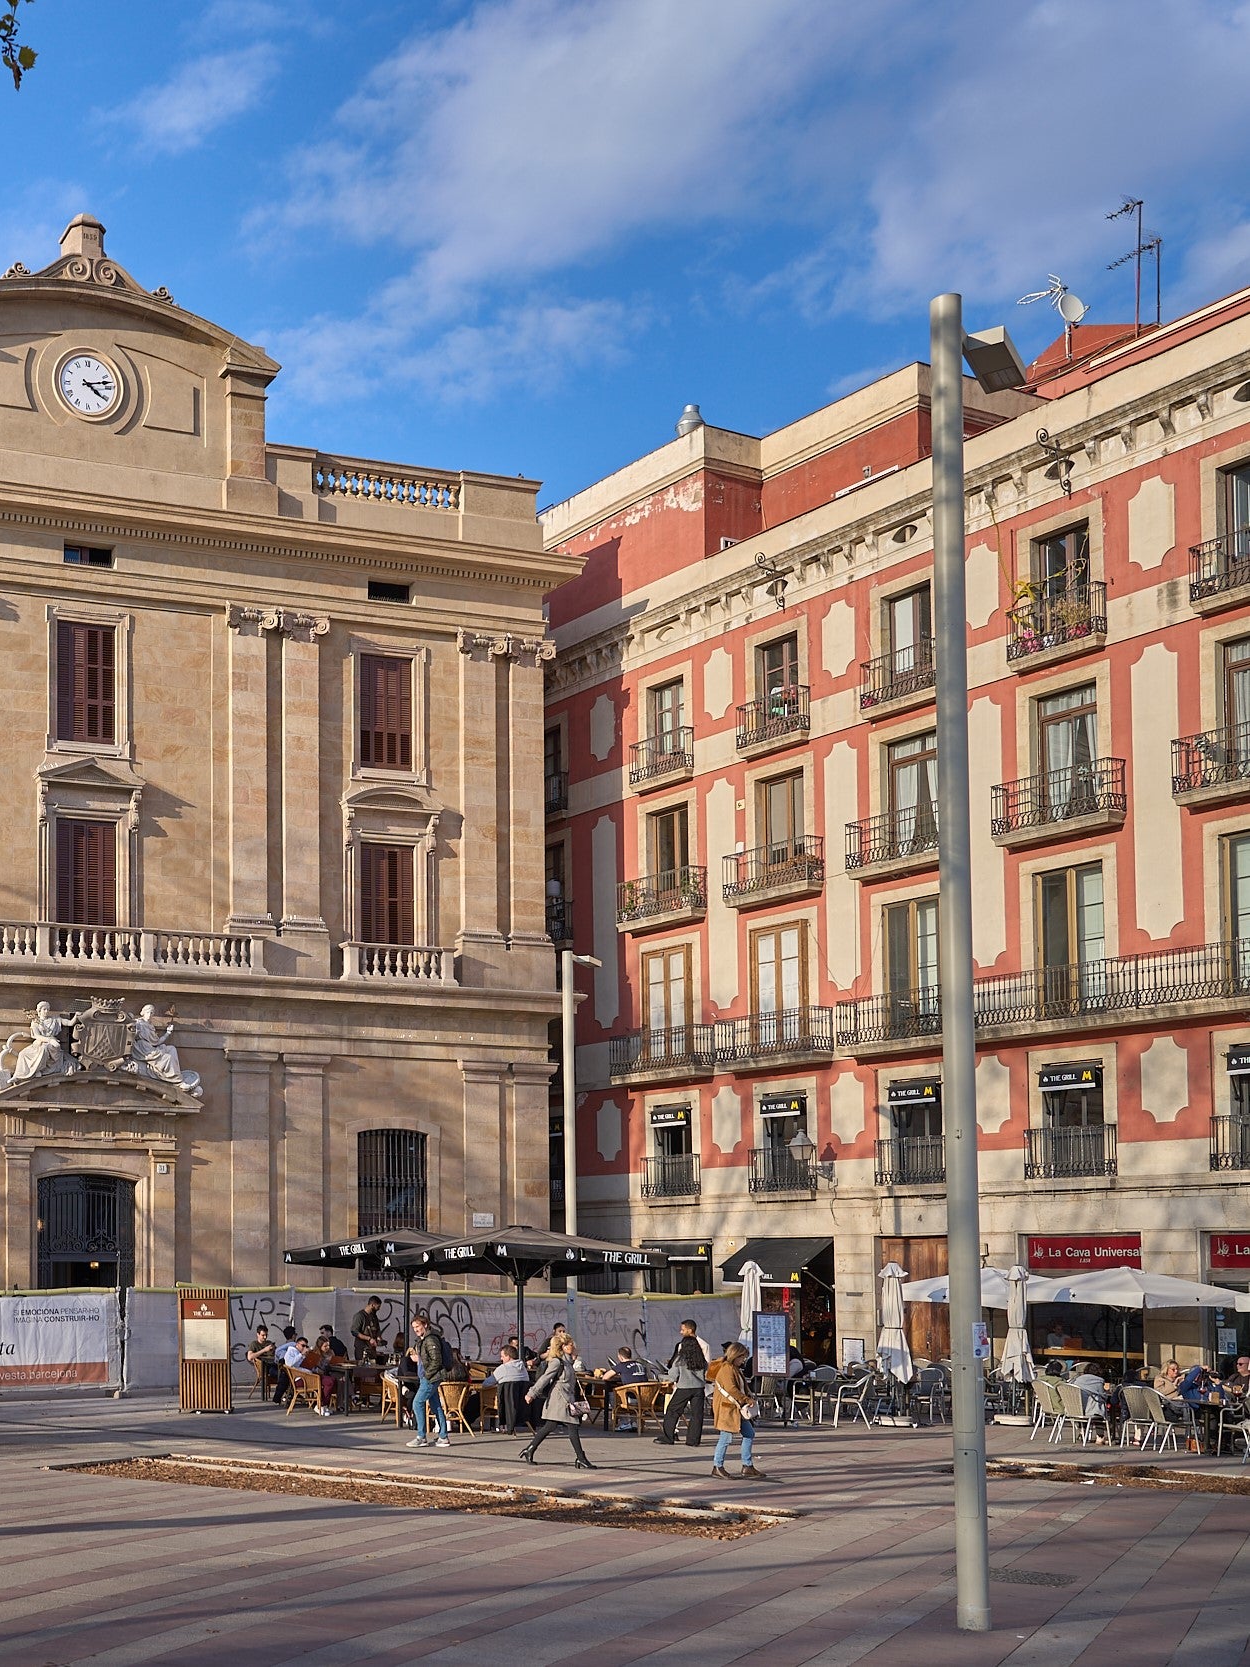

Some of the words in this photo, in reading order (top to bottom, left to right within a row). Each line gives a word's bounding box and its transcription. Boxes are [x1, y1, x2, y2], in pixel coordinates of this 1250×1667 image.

[1050, 1074, 1061, 1082] THE
[339, 1245, 351, 1257] THE
[351, 1243, 368, 1255] GRILL
[444, 1247, 457, 1260] THE
[457, 1245, 476, 1258] GRILL
[1048, 1247, 1061, 1257] La
[1065, 1247, 1091, 1258] Cava
[602, 1250, 623, 1263] THE
[624, 1252, 651, 1266] GRILL
[21, 1308, 60, 1316] EMOCIONA
[60, 1307, 100, 1315] PENSAR-HO
[13, 1315, 43, 1324] IMAGINA
[44, 1315, 100, 1323] CONSTRUIR-HO
